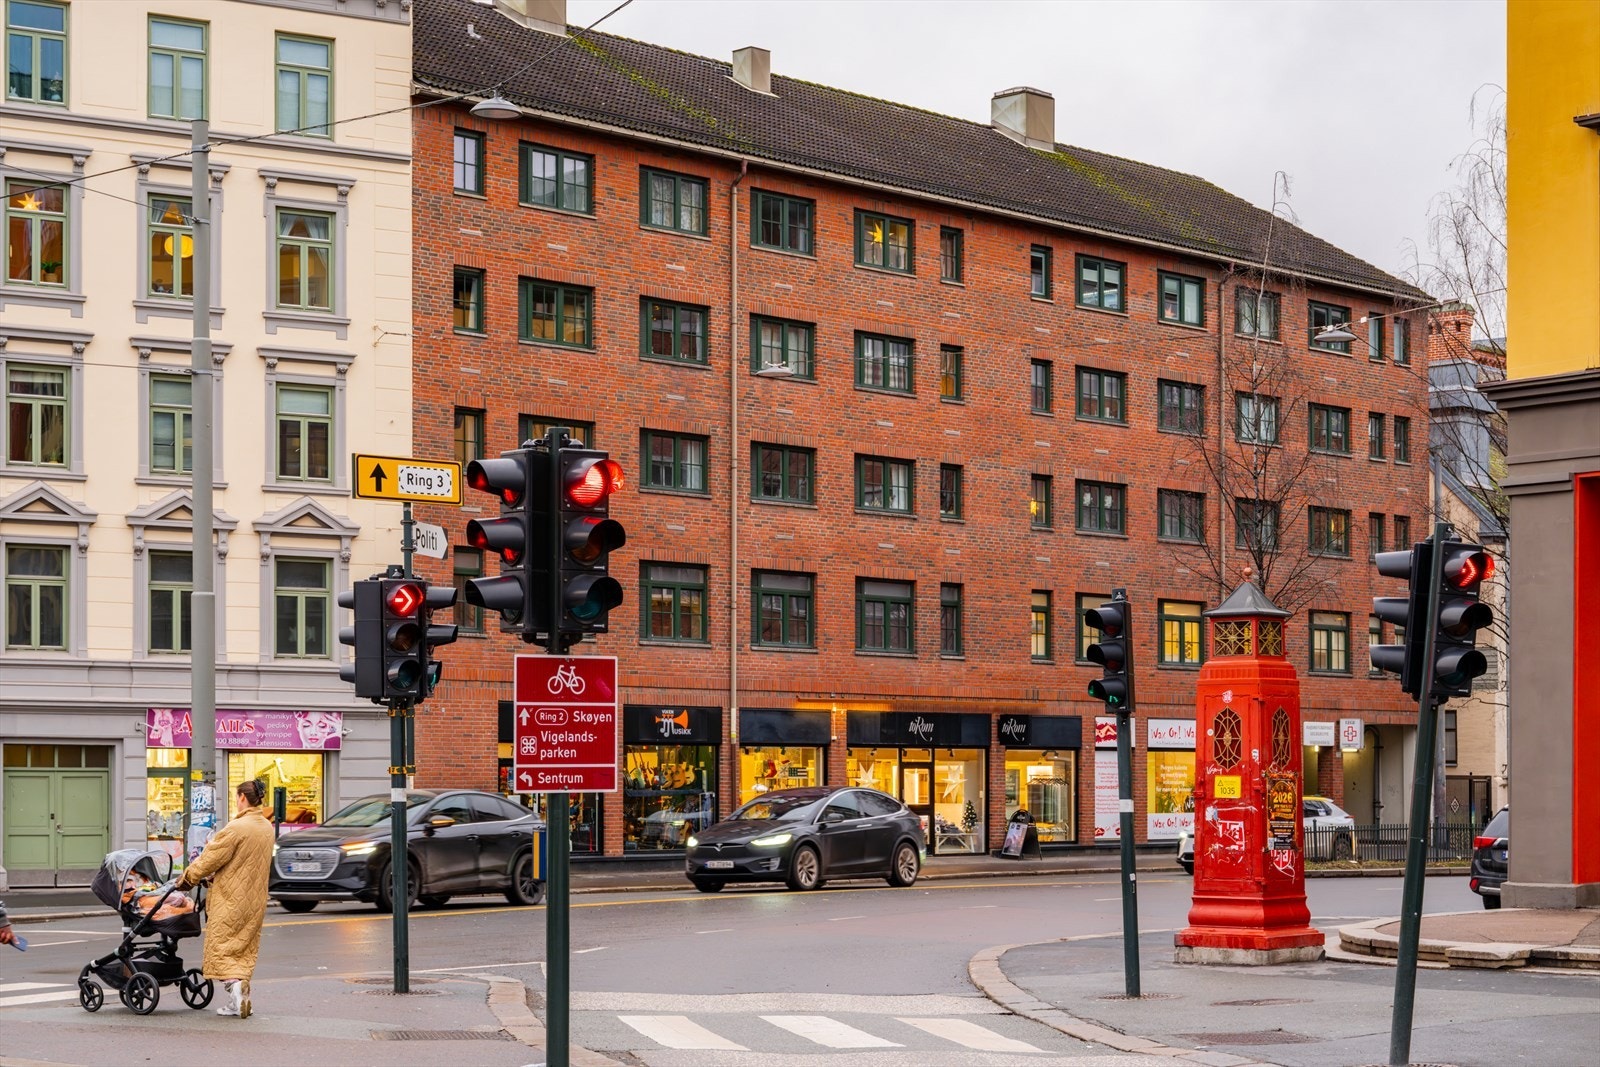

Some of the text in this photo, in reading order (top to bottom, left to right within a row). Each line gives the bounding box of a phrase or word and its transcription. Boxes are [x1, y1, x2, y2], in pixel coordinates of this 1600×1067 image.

[407, 472, 444, 490] Ring 3
[416, 527, 438, 551] Politi
[265, 713, 293, 723] manikyr
[540, 710, 613, 725] Ring 2 Skøyen
[215, 719, 255, 734] AILS
[267, 721, 292, 732] pedikyr
[1184, 727, 1195, 738] Wa
[256, 731, 292, 741] øyenvippe
[540, 730, 598, 745] Vigelands-
[540, 746, 578, 761] parken
[537, 772, 584, 784] Sentrum
[1220, 787, 1236, 795] 1035
[1273, 792, 1293, 803] 2026
